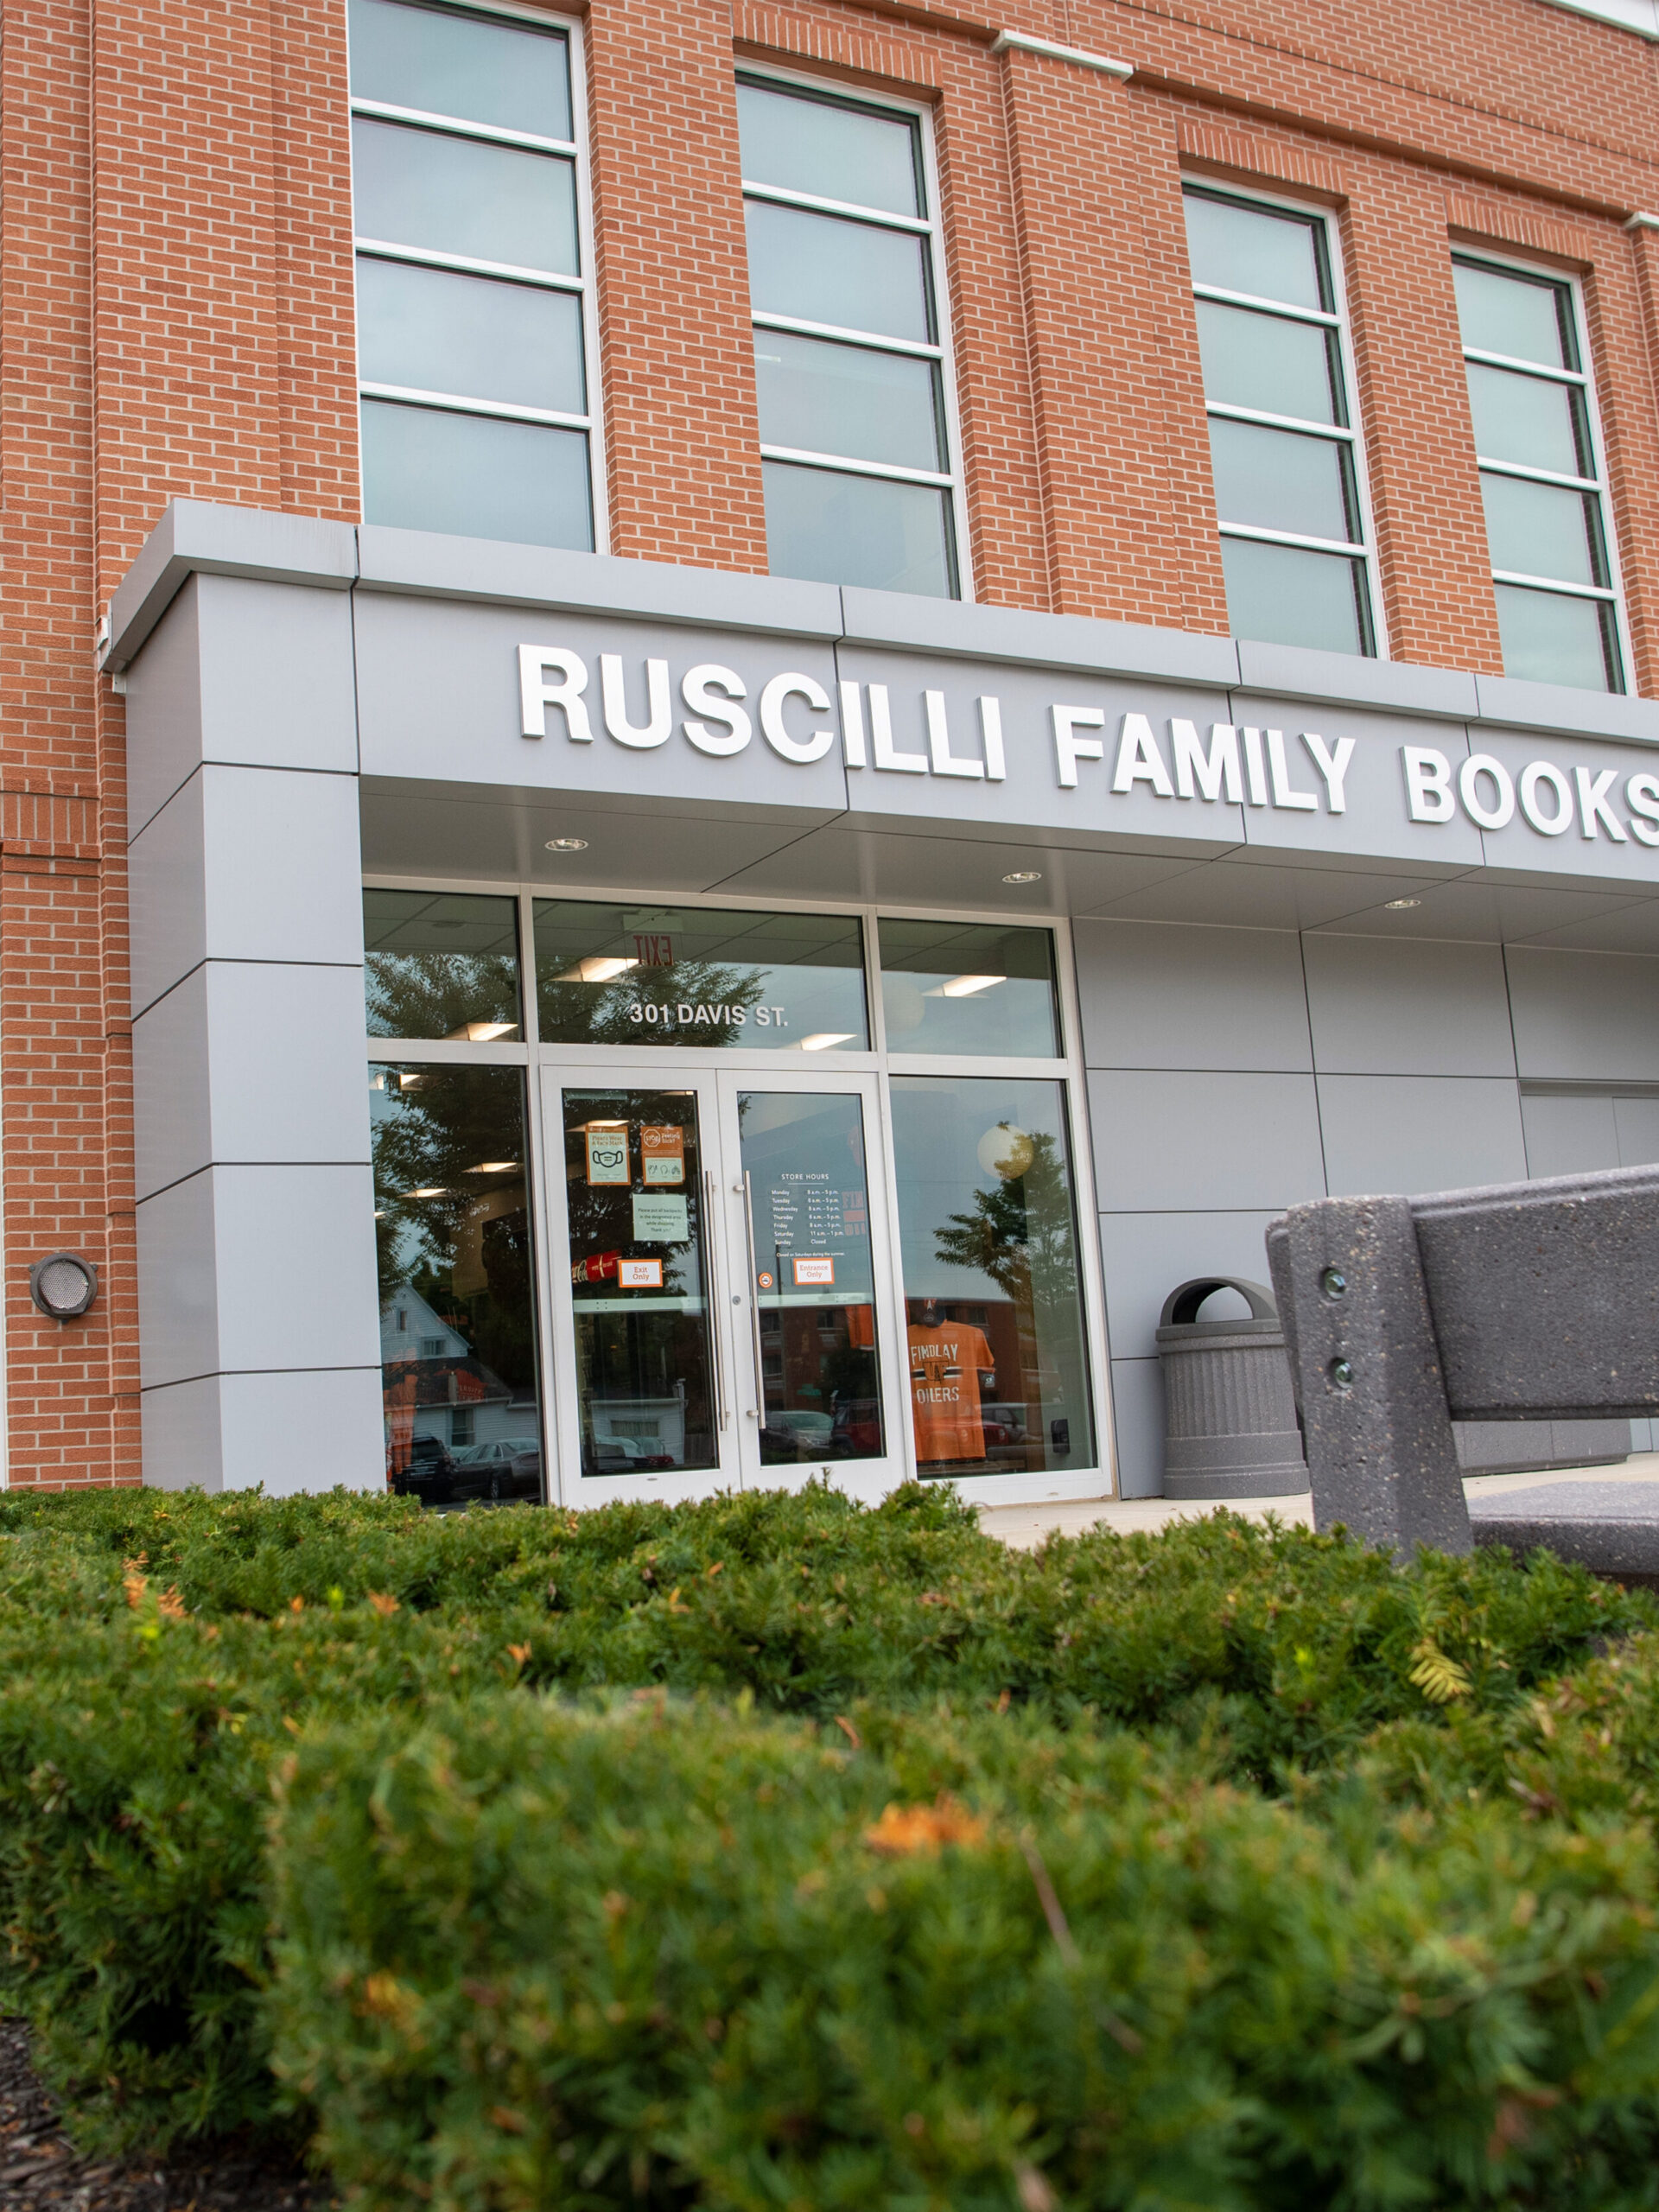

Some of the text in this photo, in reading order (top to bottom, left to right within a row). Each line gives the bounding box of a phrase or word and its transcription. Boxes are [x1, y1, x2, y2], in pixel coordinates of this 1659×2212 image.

[518, 644, 1659, 847] RUSCILLI FAMILY BOOKS
[629, 1003, 789, 1027] 301 DAVIS ST.
[910, 1344, 958, 1365] FINDLAY
[916, 1386, 960, 1404] OILERS
